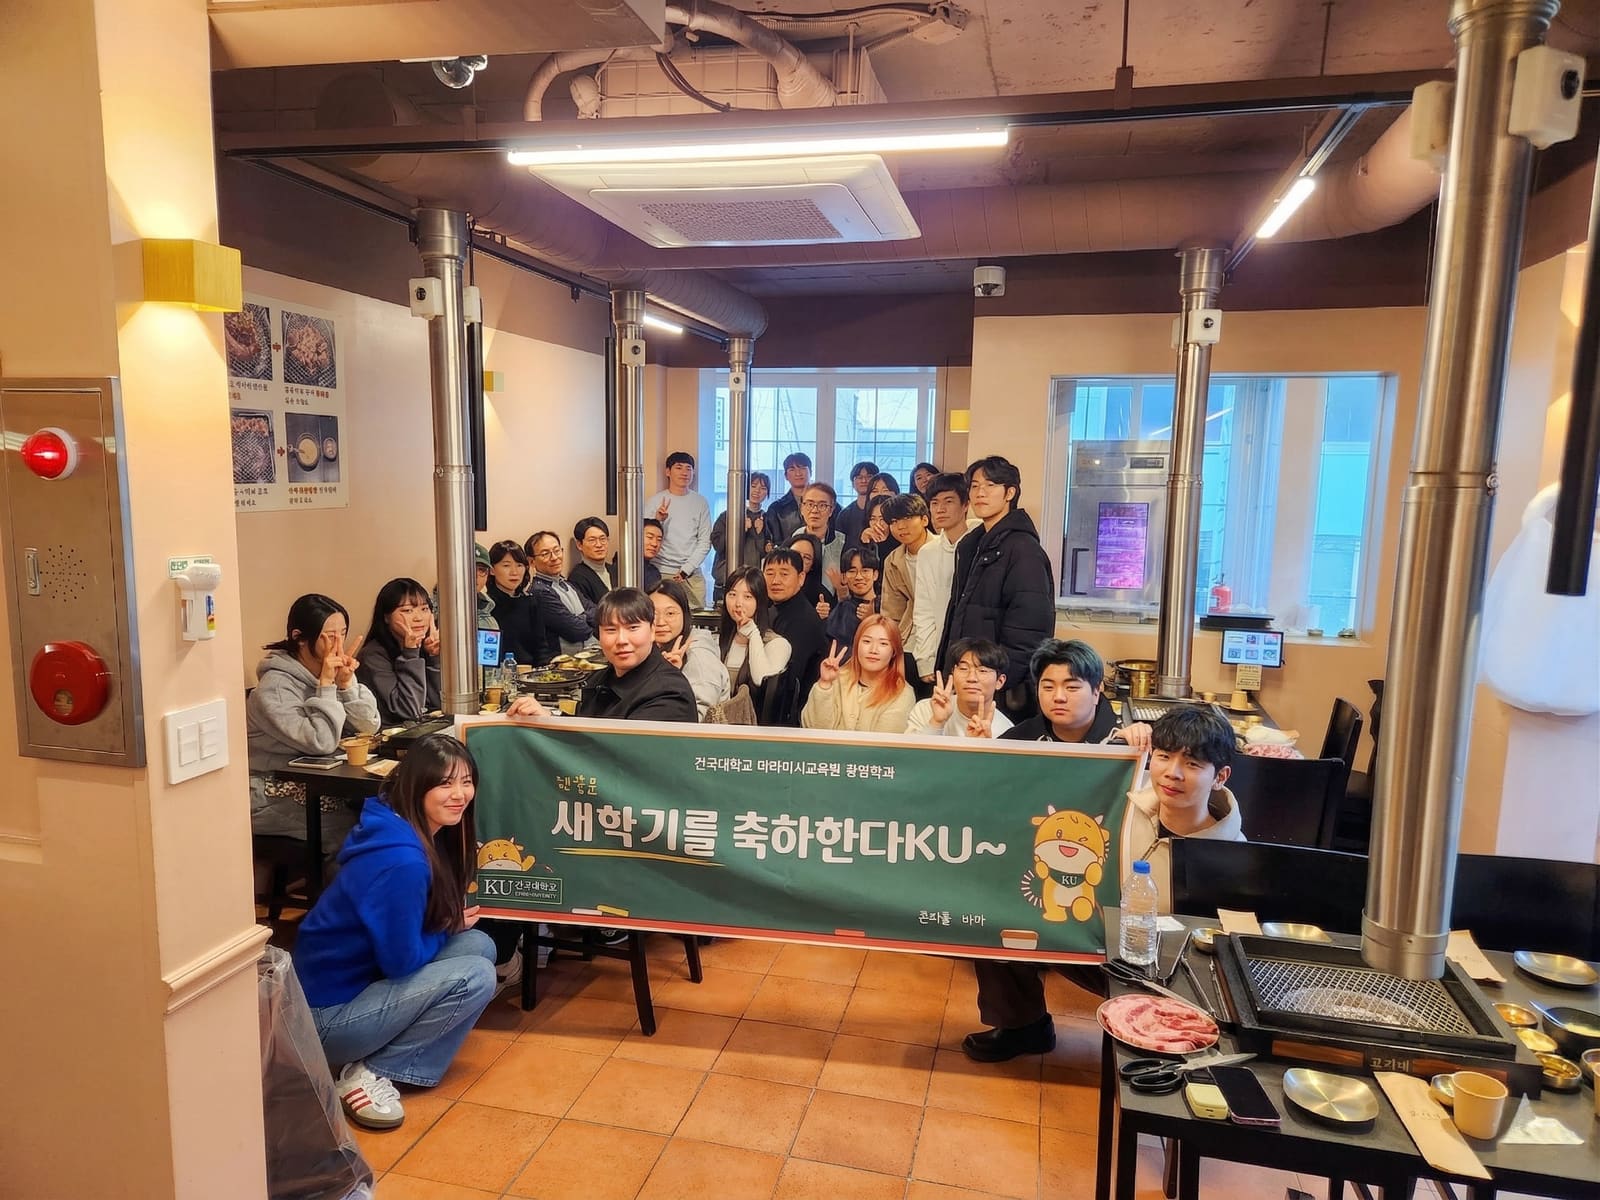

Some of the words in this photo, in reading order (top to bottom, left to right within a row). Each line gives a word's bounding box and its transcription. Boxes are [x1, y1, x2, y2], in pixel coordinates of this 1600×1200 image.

[551, 801, 718, 857] 새학기를
[733, 811, 1007, 863] 축하한다KU~
[484, 879, 513, 895] KU
[1062, 875, 1077, 886] KU
